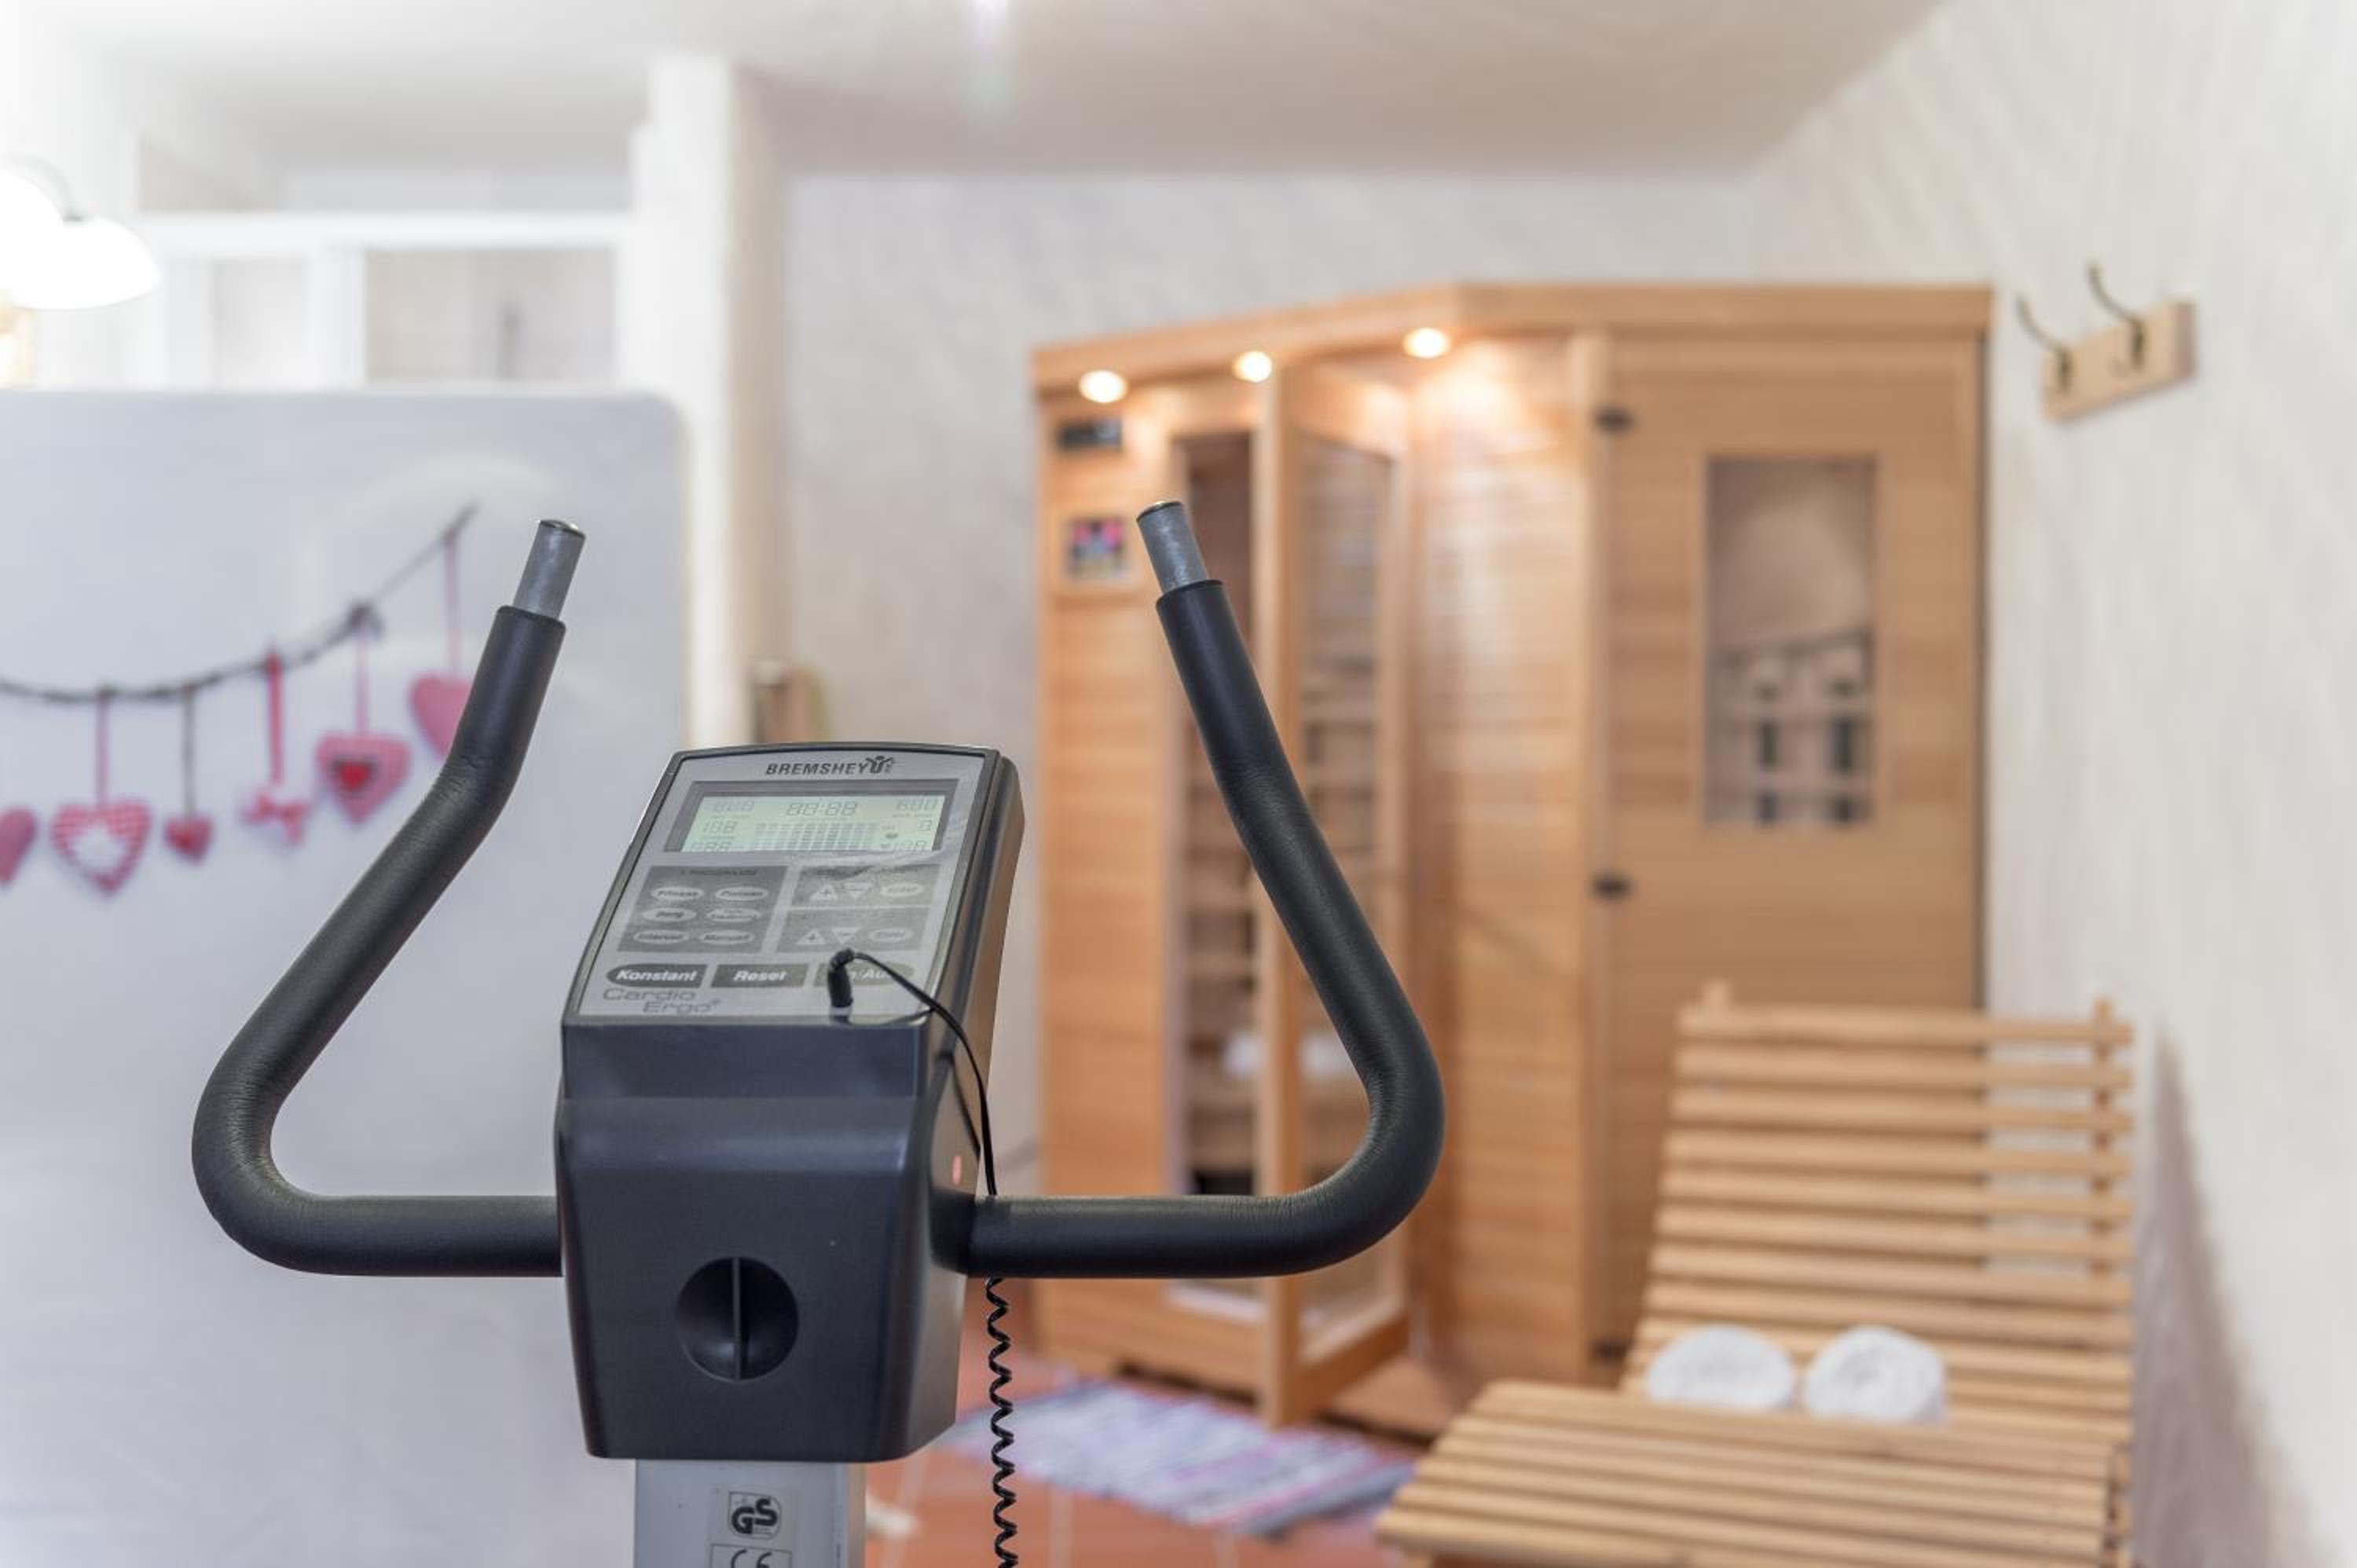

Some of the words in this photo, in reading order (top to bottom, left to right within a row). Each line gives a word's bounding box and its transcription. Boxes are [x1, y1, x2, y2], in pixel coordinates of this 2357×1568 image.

[766, 762, 867, 775] BREMSHEY
[616, 969, 698, 981] Konstant
[733, 969, 787, 981] Reset
[603, 987, 695, 1001] Cardio
